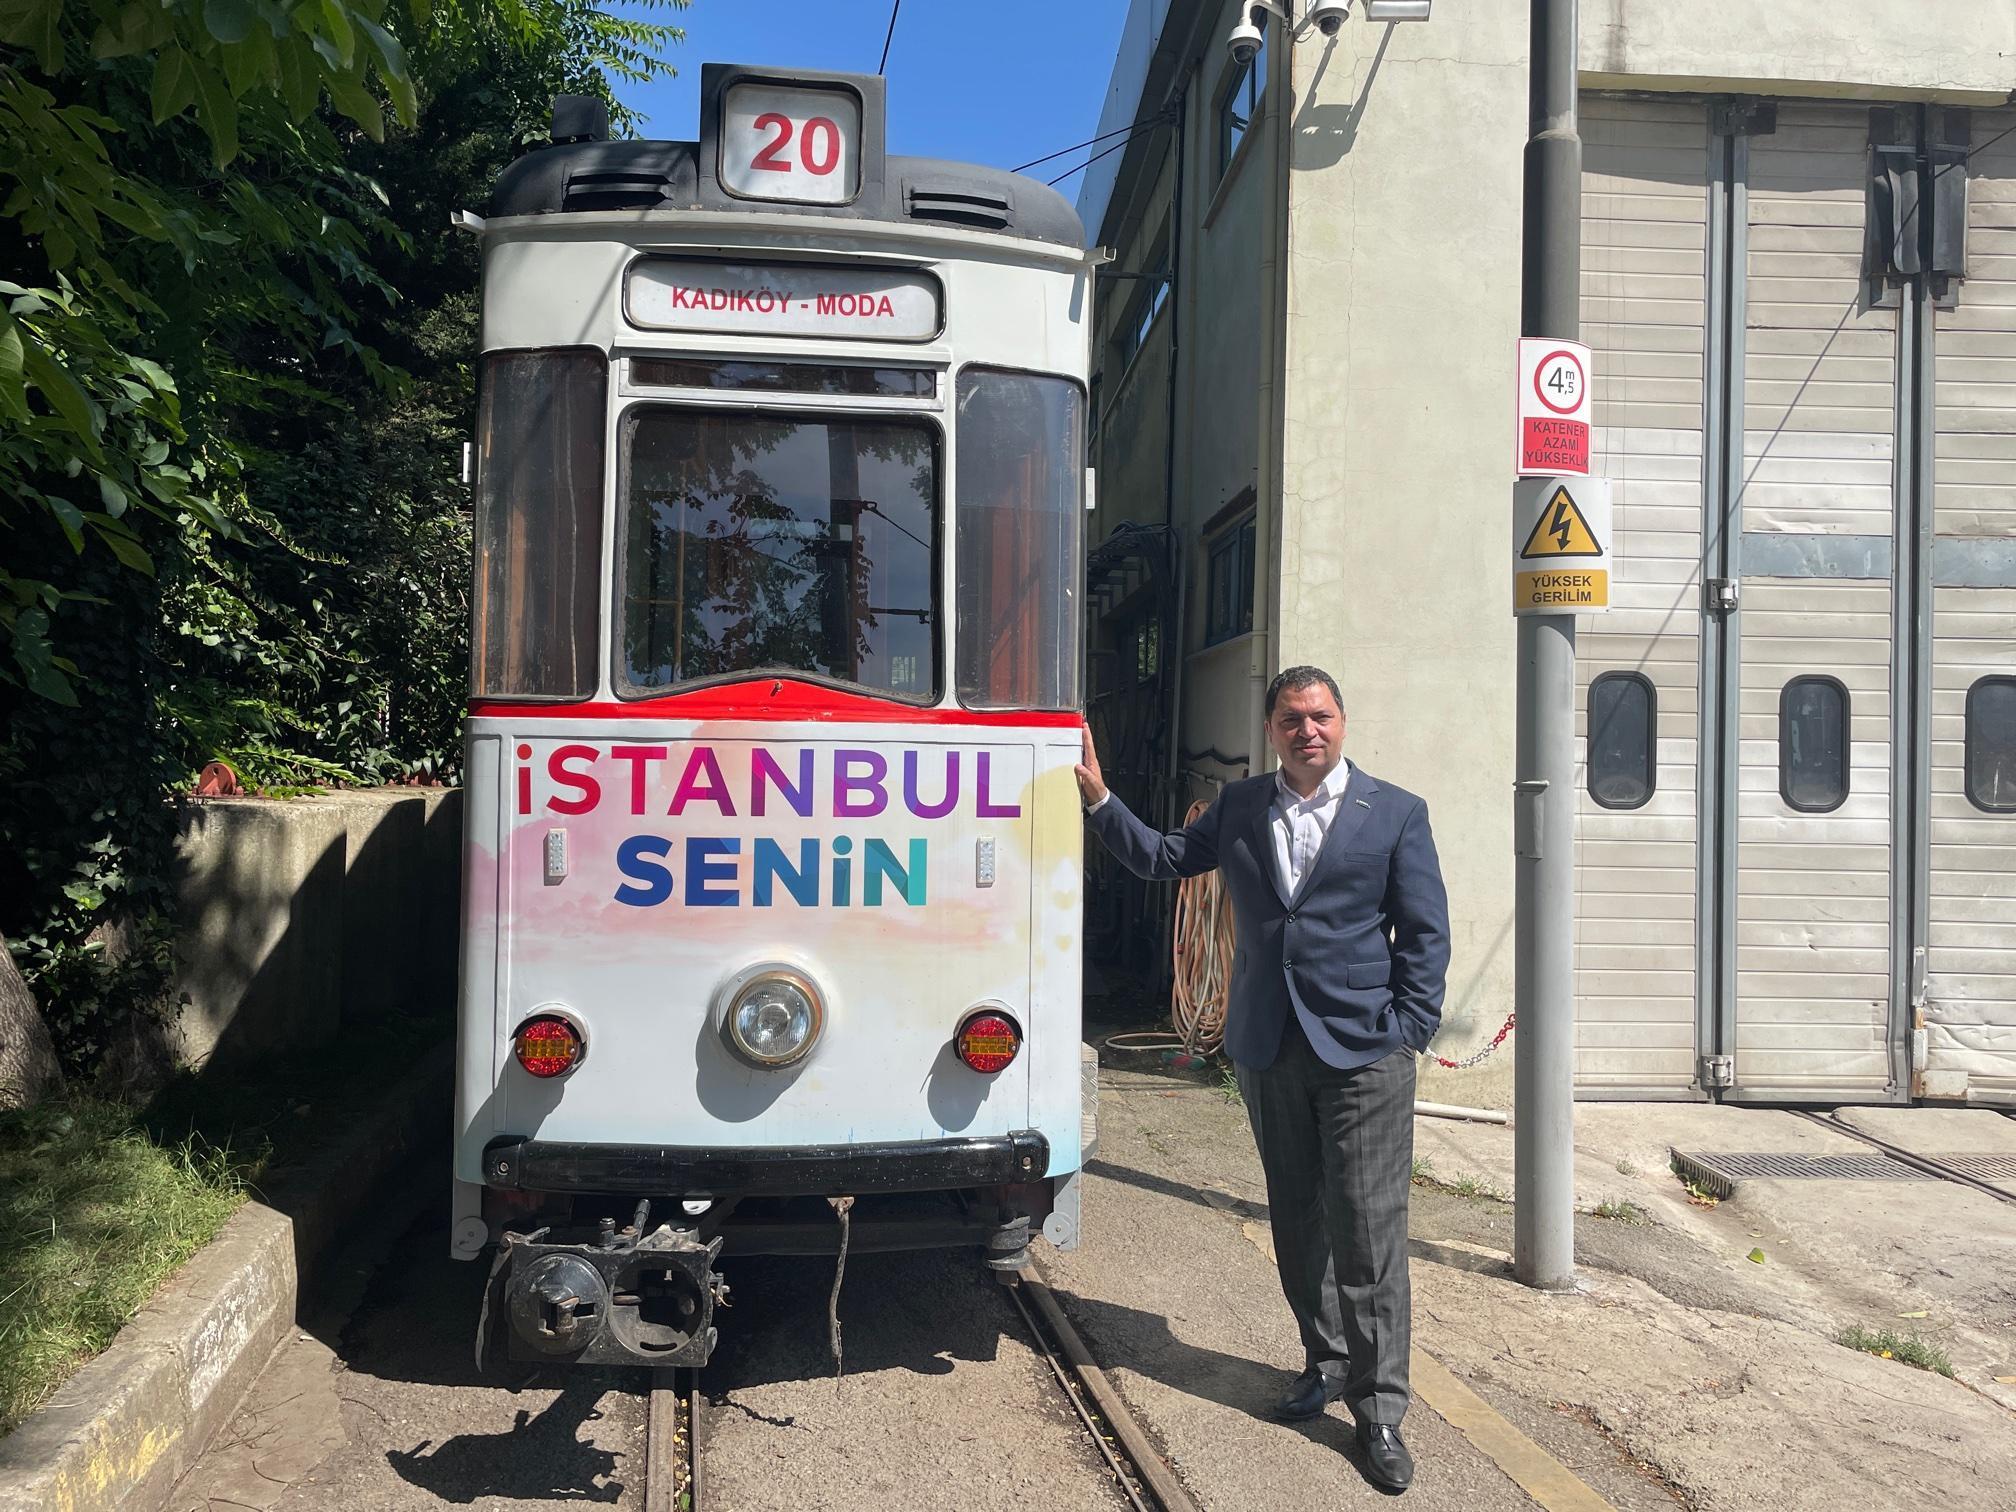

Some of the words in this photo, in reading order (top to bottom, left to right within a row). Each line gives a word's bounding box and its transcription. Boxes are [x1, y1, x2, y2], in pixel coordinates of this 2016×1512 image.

[750, 112, 841, 176] 20
[672, 284, 792, 314] KADIKÖY
[816, 293, 893, 318] MODA
[1533, 421, 1585, 438] KATENER
[1542, 436, 1580, 452] AZAMİ
[1531, 574, 1593, 588] YÜKSEK
[1532, 588, 1592, 604] GERİLİM
